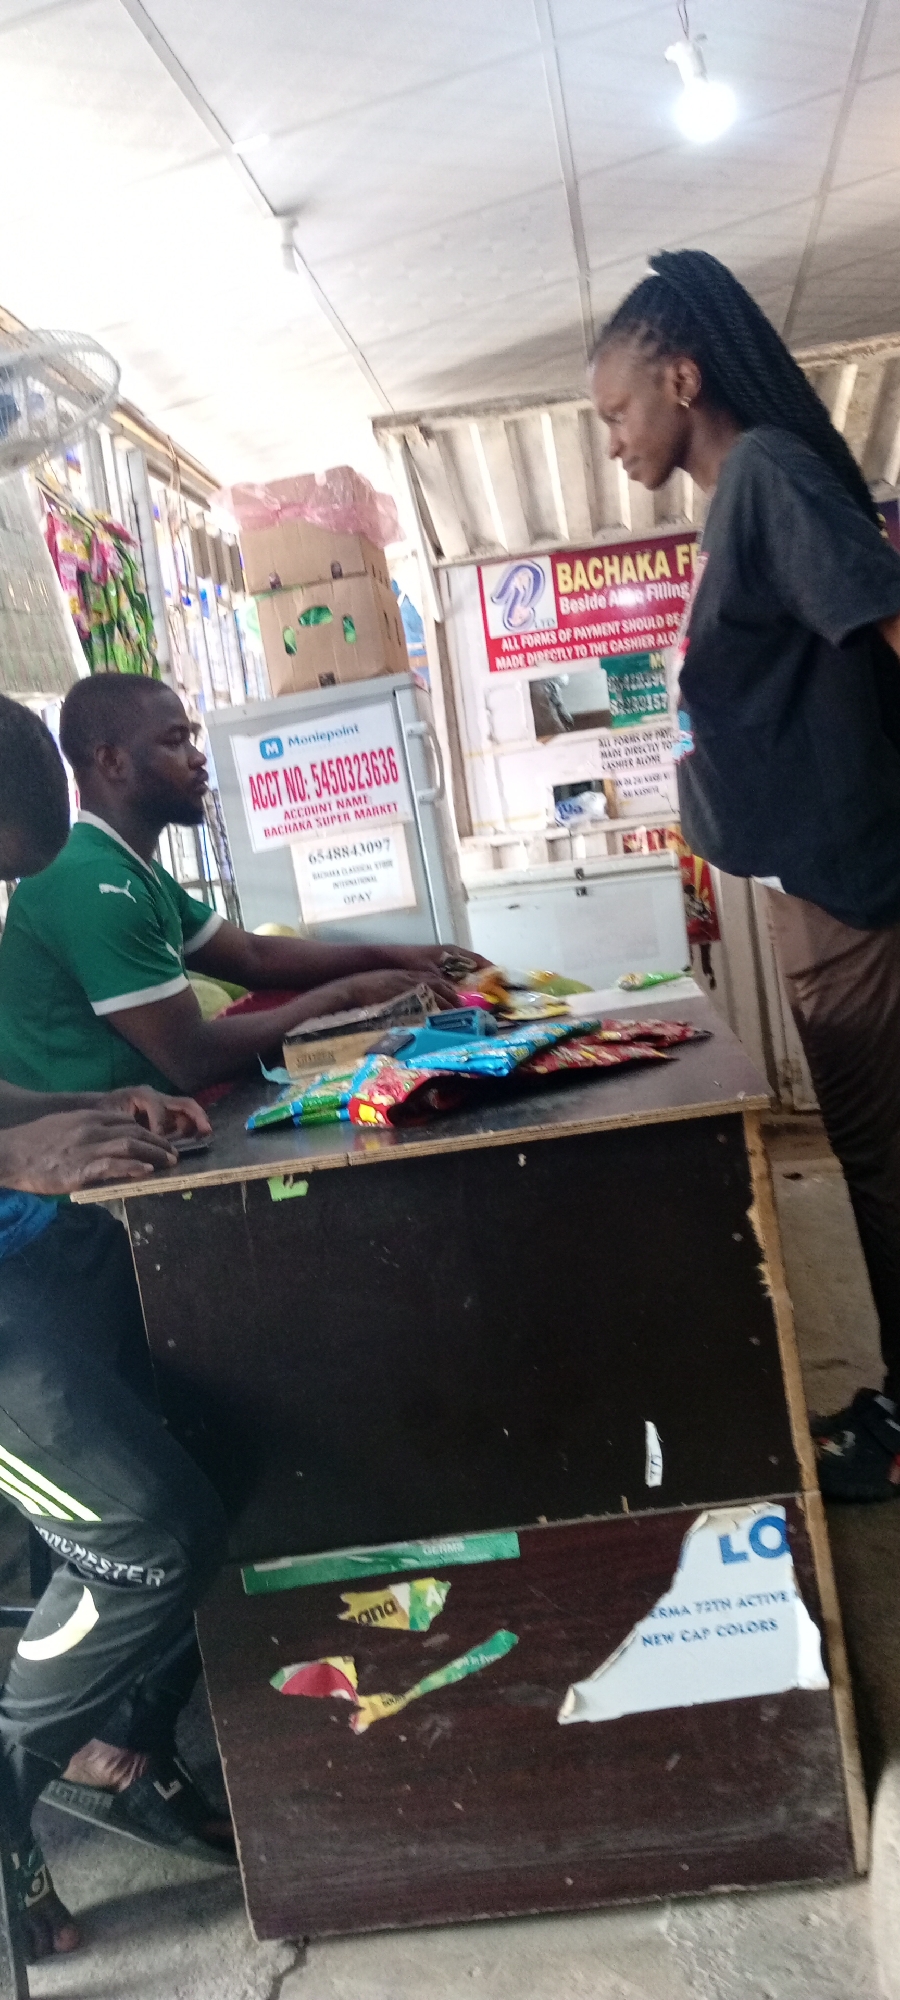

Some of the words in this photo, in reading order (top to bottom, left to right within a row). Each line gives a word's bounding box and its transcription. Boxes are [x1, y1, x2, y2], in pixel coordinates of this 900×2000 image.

[556, 549, 672, 594] BACHAKA
[559, 592, 607, 615] Beside
[502, 635, 520, 652] ALL
[521, 630, 557, 649] FORMS
[558, 627, 573, 644] OF
[573, 622, 621, 642] PAYMENT
[622, 614, 664, 634] SHOULD
[495, 653, 527, 671] MADE
[527, 645, 574, 664] DIRECTLY
[574, 643, 588, 659] TO
[588, 641, 609, 657] THE
[609, 635, 656, 654] CASHIER
[288, 723, 359, 747] Moniepoint
[598, 738, 611, 748] ALL
[614, 732, 641, 746] FORMS
[600, 749, 623, 759] MADE
[624, 741, 660, 757] DIRECTLY
[636, 754, 661, 766] ALONE
[249, 769, 283, 812] ACCT
[283, 765, 311, 804] NO:
[310, 746, 399, 799] 5450323636
[263, 819, 313, 838] BACHAKA
[315, 811, 351, 828] SUPER
[354, 802, 398, 821] MARKET
[284, 802, 332, 821] ACCOUNT
[308, 836, 390, 866] 6548843097
[343, 890, 372, 905] OPAY
[738, 1590, 790, 1609] ACTIVE
[641, 1630, 675, 1648] NEW
[681, 1626, 711, 1643] CAP
[715, 1617, 779, 1638] COLORS
